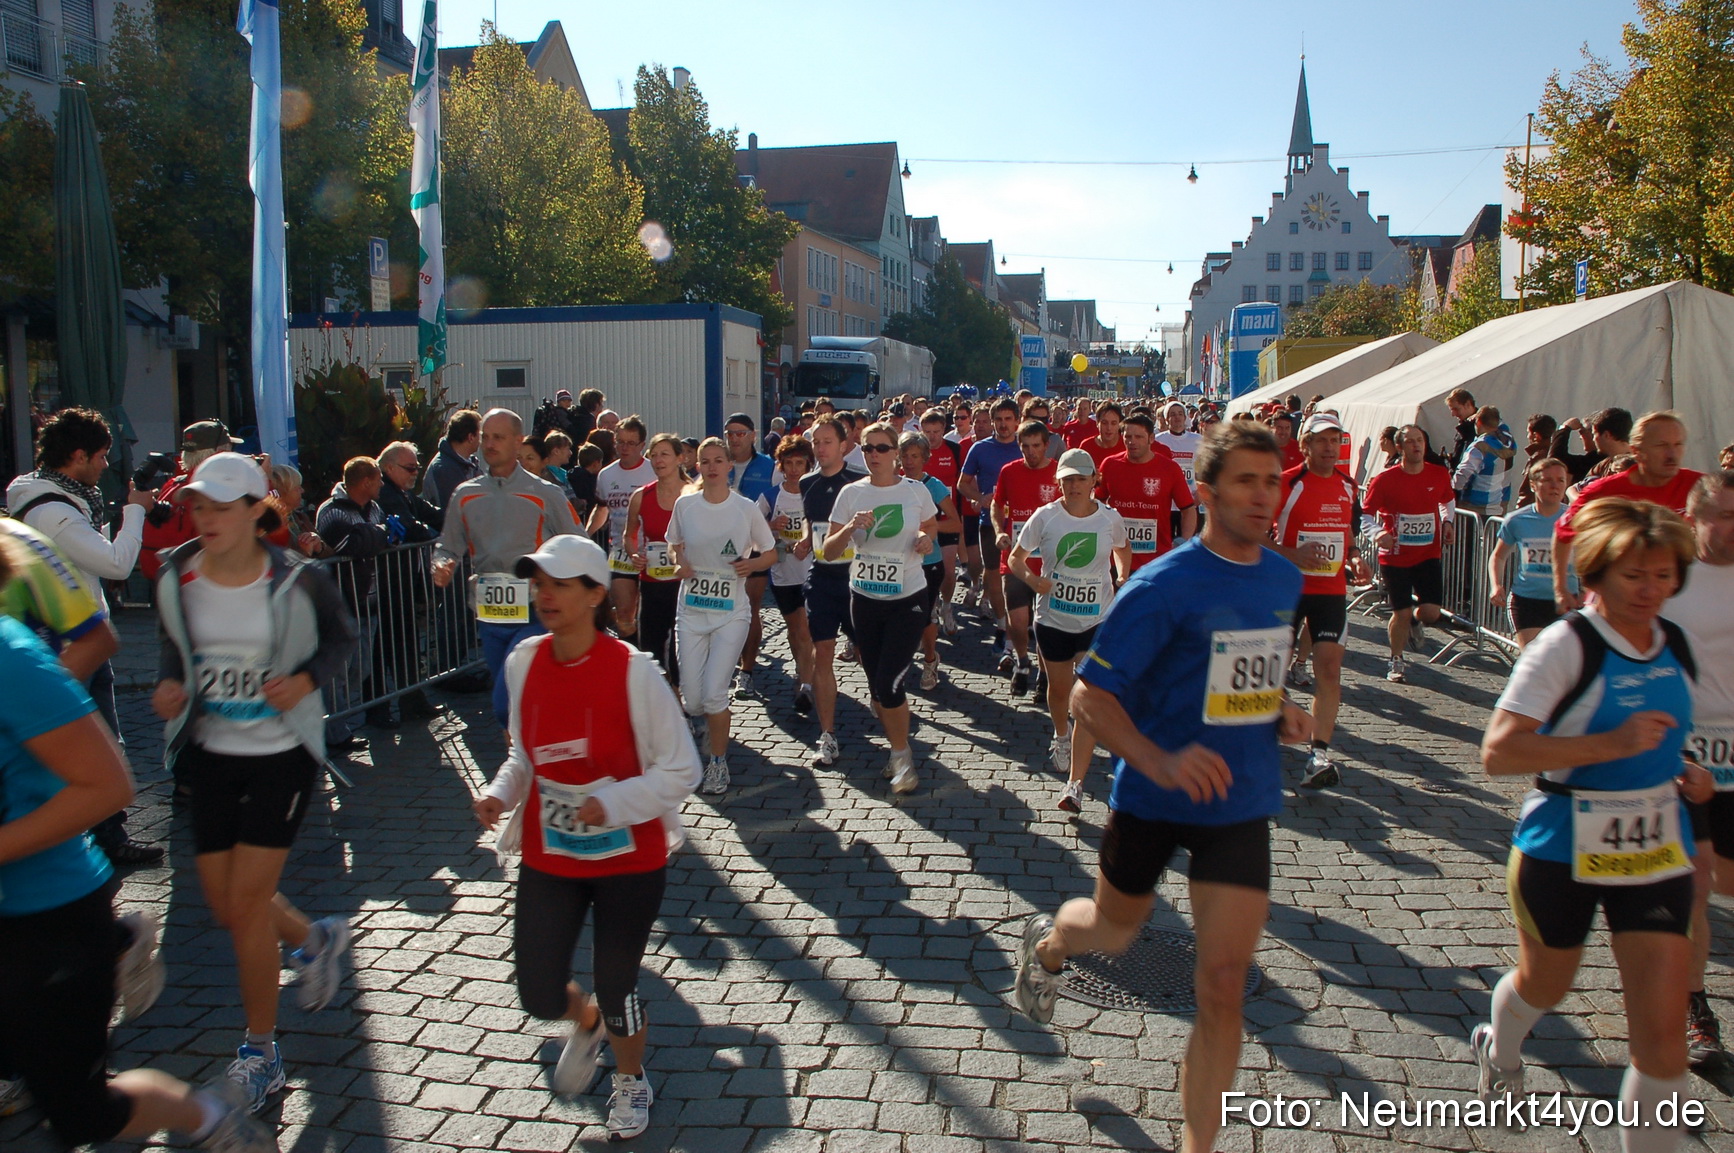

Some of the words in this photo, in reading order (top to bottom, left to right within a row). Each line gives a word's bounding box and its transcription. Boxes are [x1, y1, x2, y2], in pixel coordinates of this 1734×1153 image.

[374, 241, 384, 272] P
[1577, 265, 1585, 291] P
[1241, 311, 1276, 330] maxi
[785, 516, 806, 531] 35
[1402, 522, 1432, 535] 2522
[1124, 526, 1152, 541] 046
[857, 562, 898, 582] 2152
[485, 586, 515, 605] 500
[690, 578, 730, 598] 2946
[855, 580, 899, 593] Alexandra
[1055, 582, 1097, 603] 3056
[484, 605, 519, 617] Michael
[693, 596, 725, 608] Andrea
[1054, 600, 1094, 614] Susanne
[1229, 653, 1281, 691] 890
[1601, 815, 1664, 850] 444
